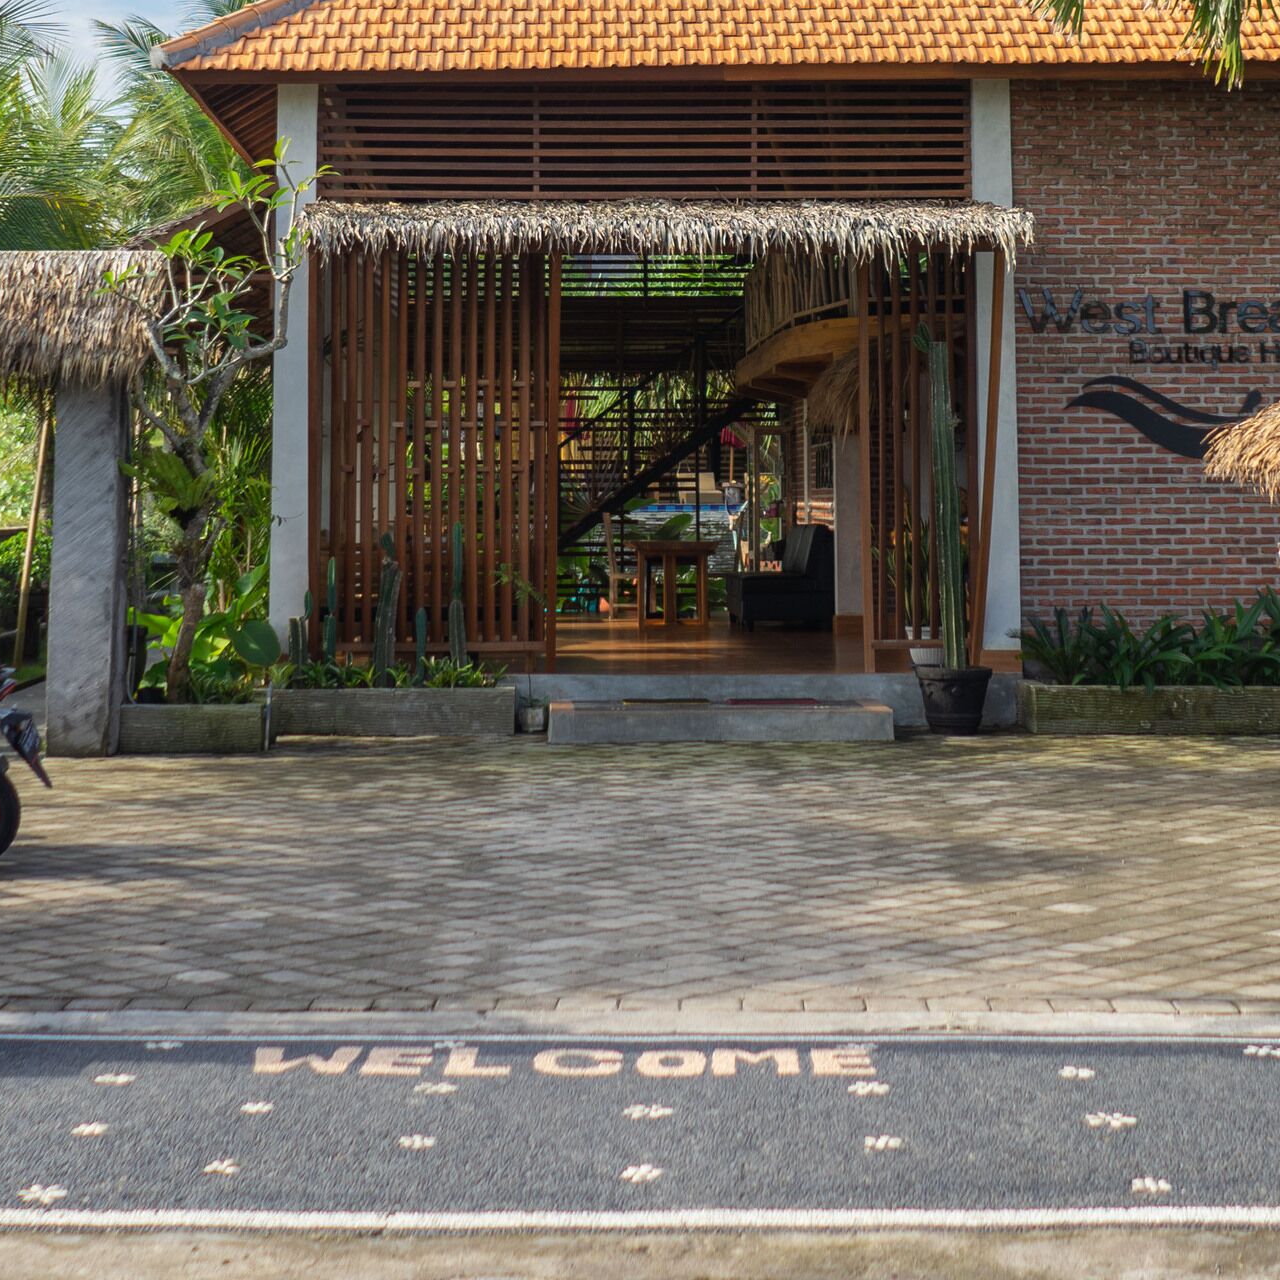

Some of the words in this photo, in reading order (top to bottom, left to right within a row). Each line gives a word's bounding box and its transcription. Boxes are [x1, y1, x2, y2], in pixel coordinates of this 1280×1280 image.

[1020, 288, 1160, 335] West
[1129, 338, 1250, 369] Boutique
[252, 1046, 877, 1077] WELCOME
